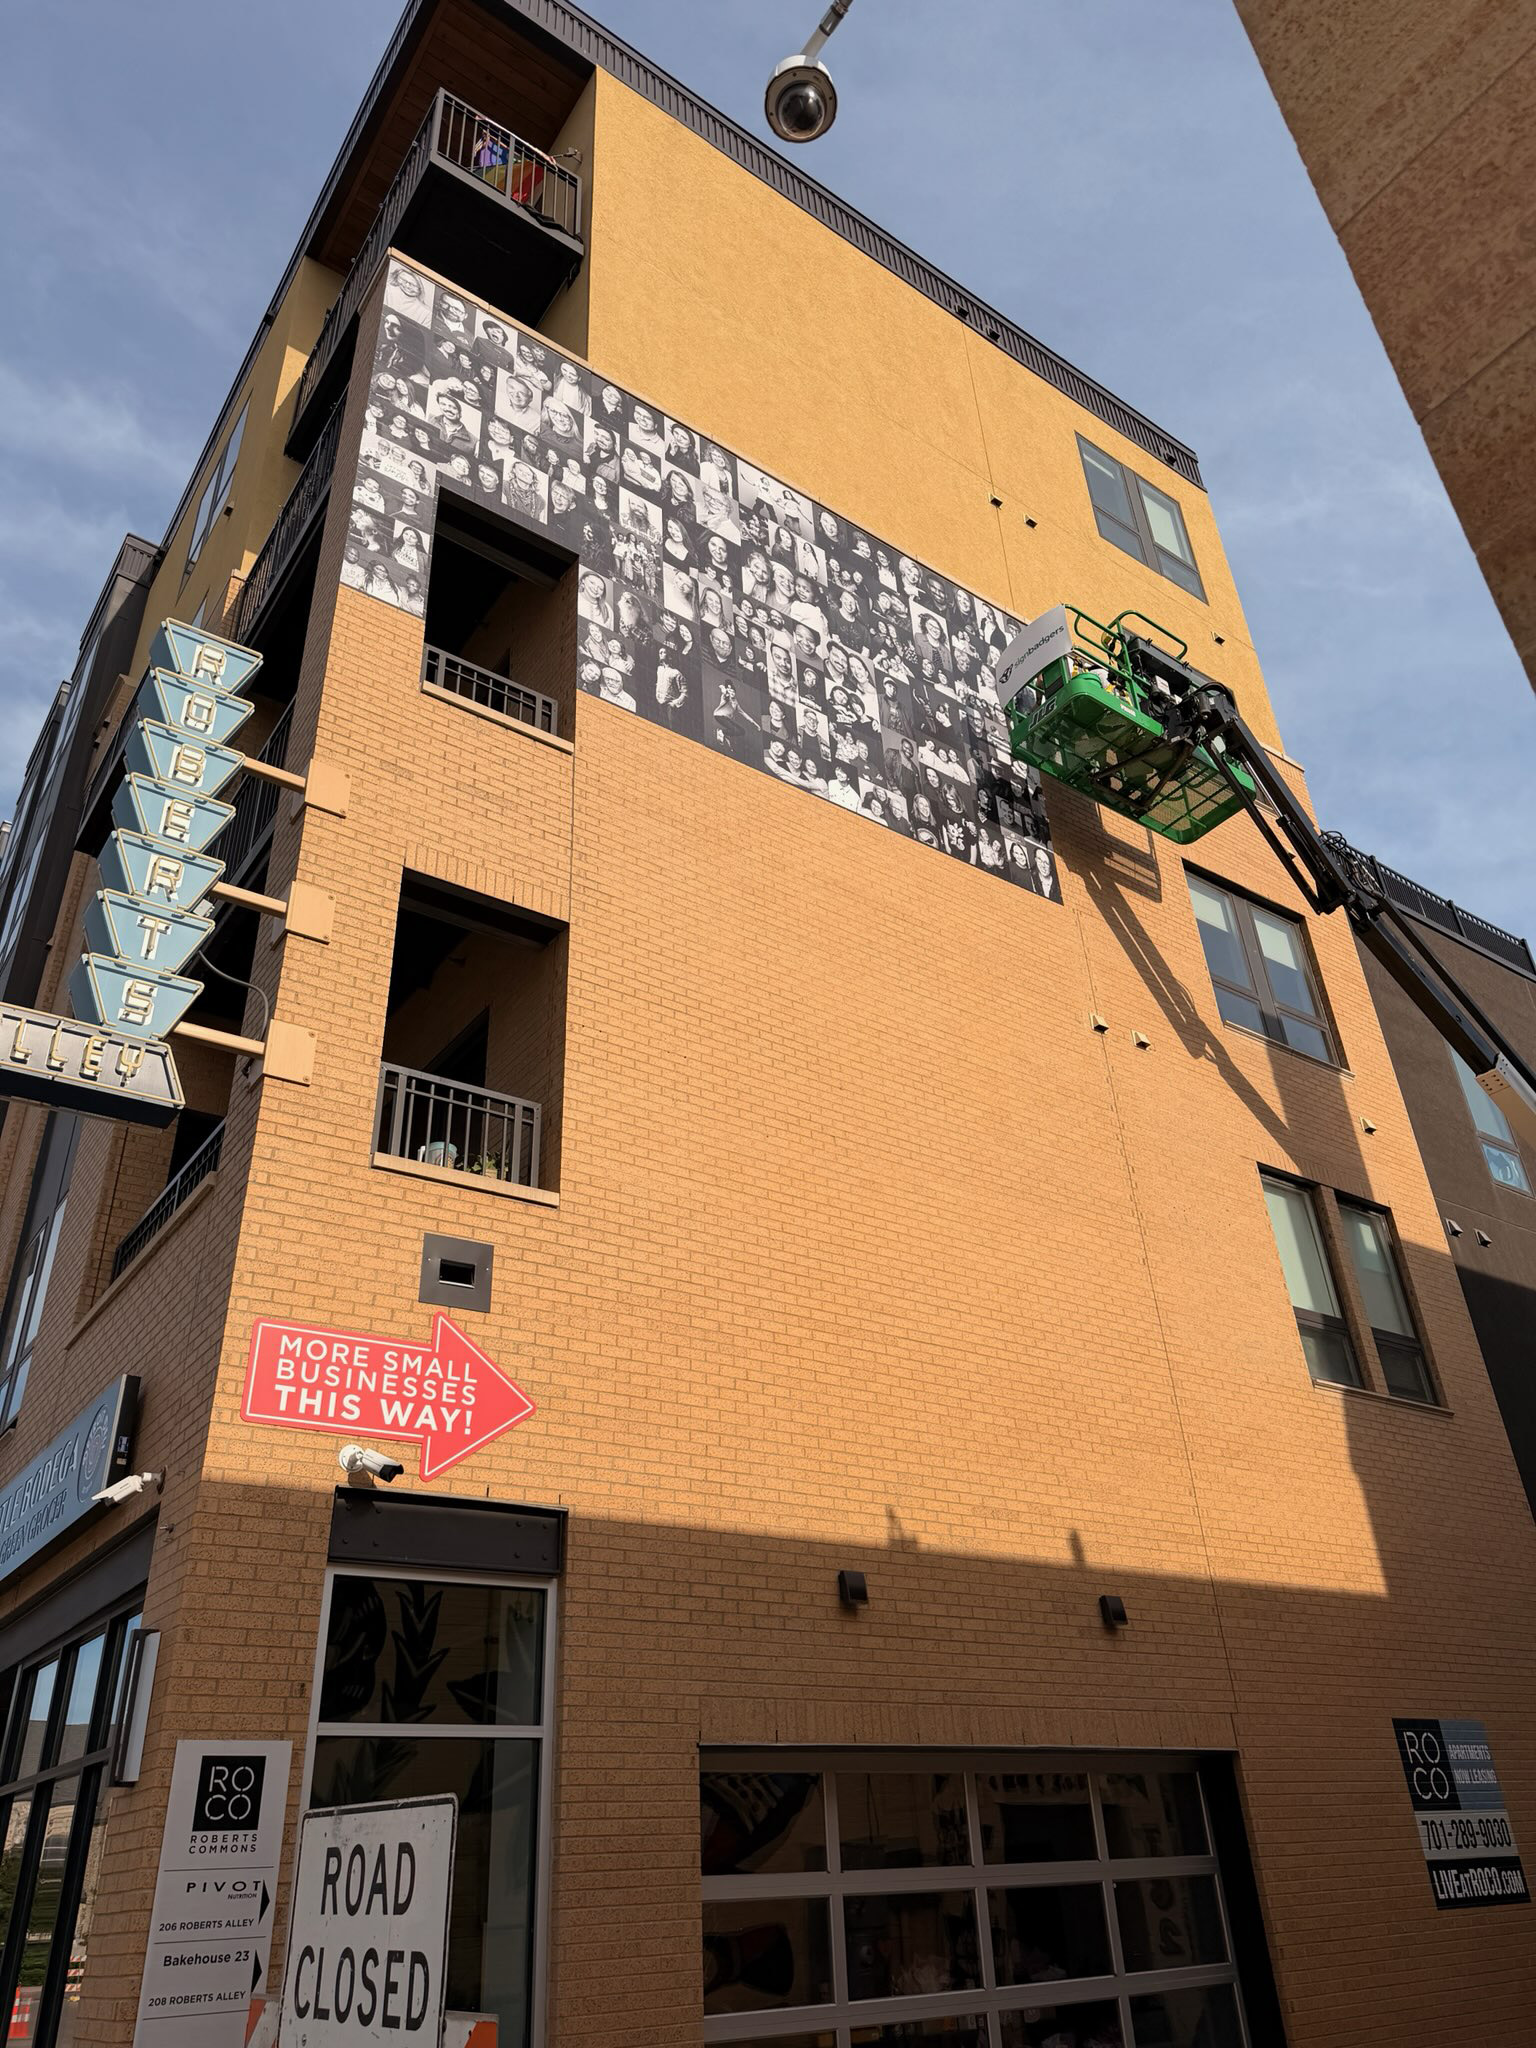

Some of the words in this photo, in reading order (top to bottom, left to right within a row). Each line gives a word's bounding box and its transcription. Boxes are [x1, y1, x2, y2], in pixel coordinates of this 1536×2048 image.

[1013, 625, 1065, 668] signbadgers
[117, 642, 228, 1027] ROBERTS
[279, 1335, 370, 1367] MORE
[382, 1351, 478, 1384] SMALL
[275, 1357, 477, 1406] BUSINESSES
[274, 1383, 362, 1421] THIS
[380, 1398, 474, 1436] WAY!
[20, 1432, 80, 1518] BODEGA
[27, 1487, 69, 1544] GROCER
[1402, 1731, 1441, 1764] RO
[1448, 1744, 1492, 1760] APARTMENTS
[208, 1765, 255, 1793] RO
[1413, 1767, 1450, 1800] CO
[1453, 1768, 1471, 1784] NOW
[1469, 1768, 1498, 1784] LEASING
[205, 1794, 252, 1821] CO
[188, 1844, 257, 1854] COMMONS
[189, 1834, 258, 1844] ROBERTS
[1421, 1818, 1513, 1851] 701-289-9030
[186, 1881, 262, 1893] PIVOT
[320, 1841, 416, 1917] ROAD
[158, 1922, 177, 1932] 206
[179, 1920, 223, 1931] ROBERTS
[225, 1918, 255, 1928] ALLEY
[163, 1953, 231, 1967] Bakehouse
[234, 1951, 250, 1962] 23
[148, 1997, 167, 2008] 208
[169, 1993, 214, 2005] ROBERTS
[216, 1990, 246, 2001] ALLEY
[294, 1944, 430, 2032] CLOSED
